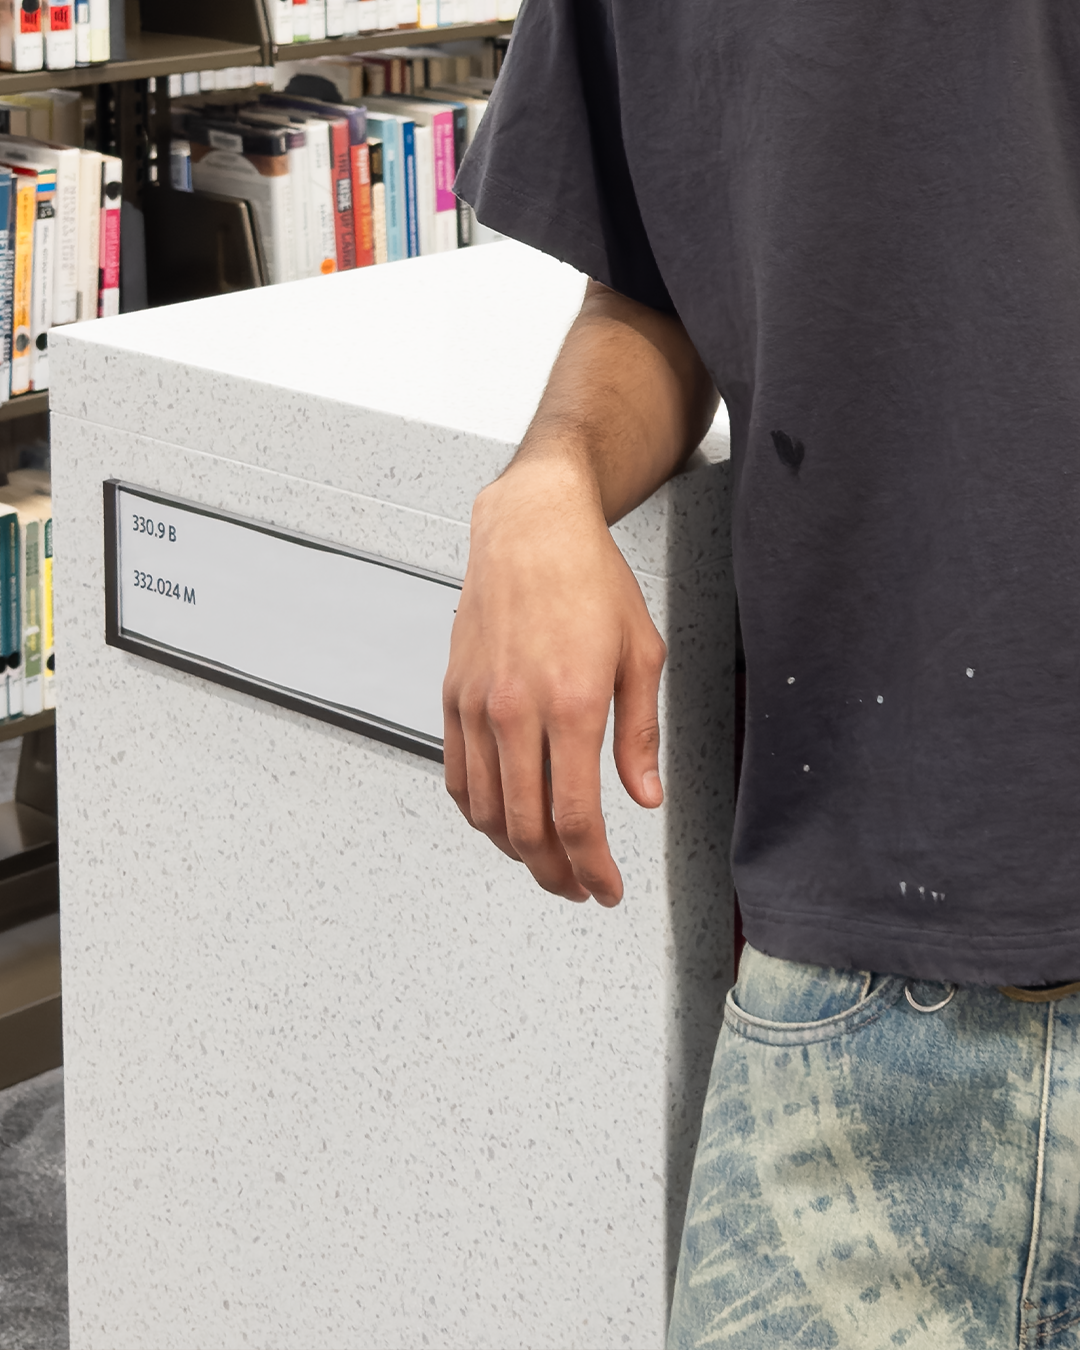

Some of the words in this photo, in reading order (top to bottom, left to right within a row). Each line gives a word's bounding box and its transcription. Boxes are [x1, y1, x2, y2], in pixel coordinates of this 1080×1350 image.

[338, 153, 348, 177] THE
[357, 148, 369, 184] Beyond
[338, 179, 350, 211] RISE
[132, 514, 166, 539] 330.9
[168, 526, 177, 543] B
[133, 570, 181, 600] 332.024
[184, 587, 196, 606] M
